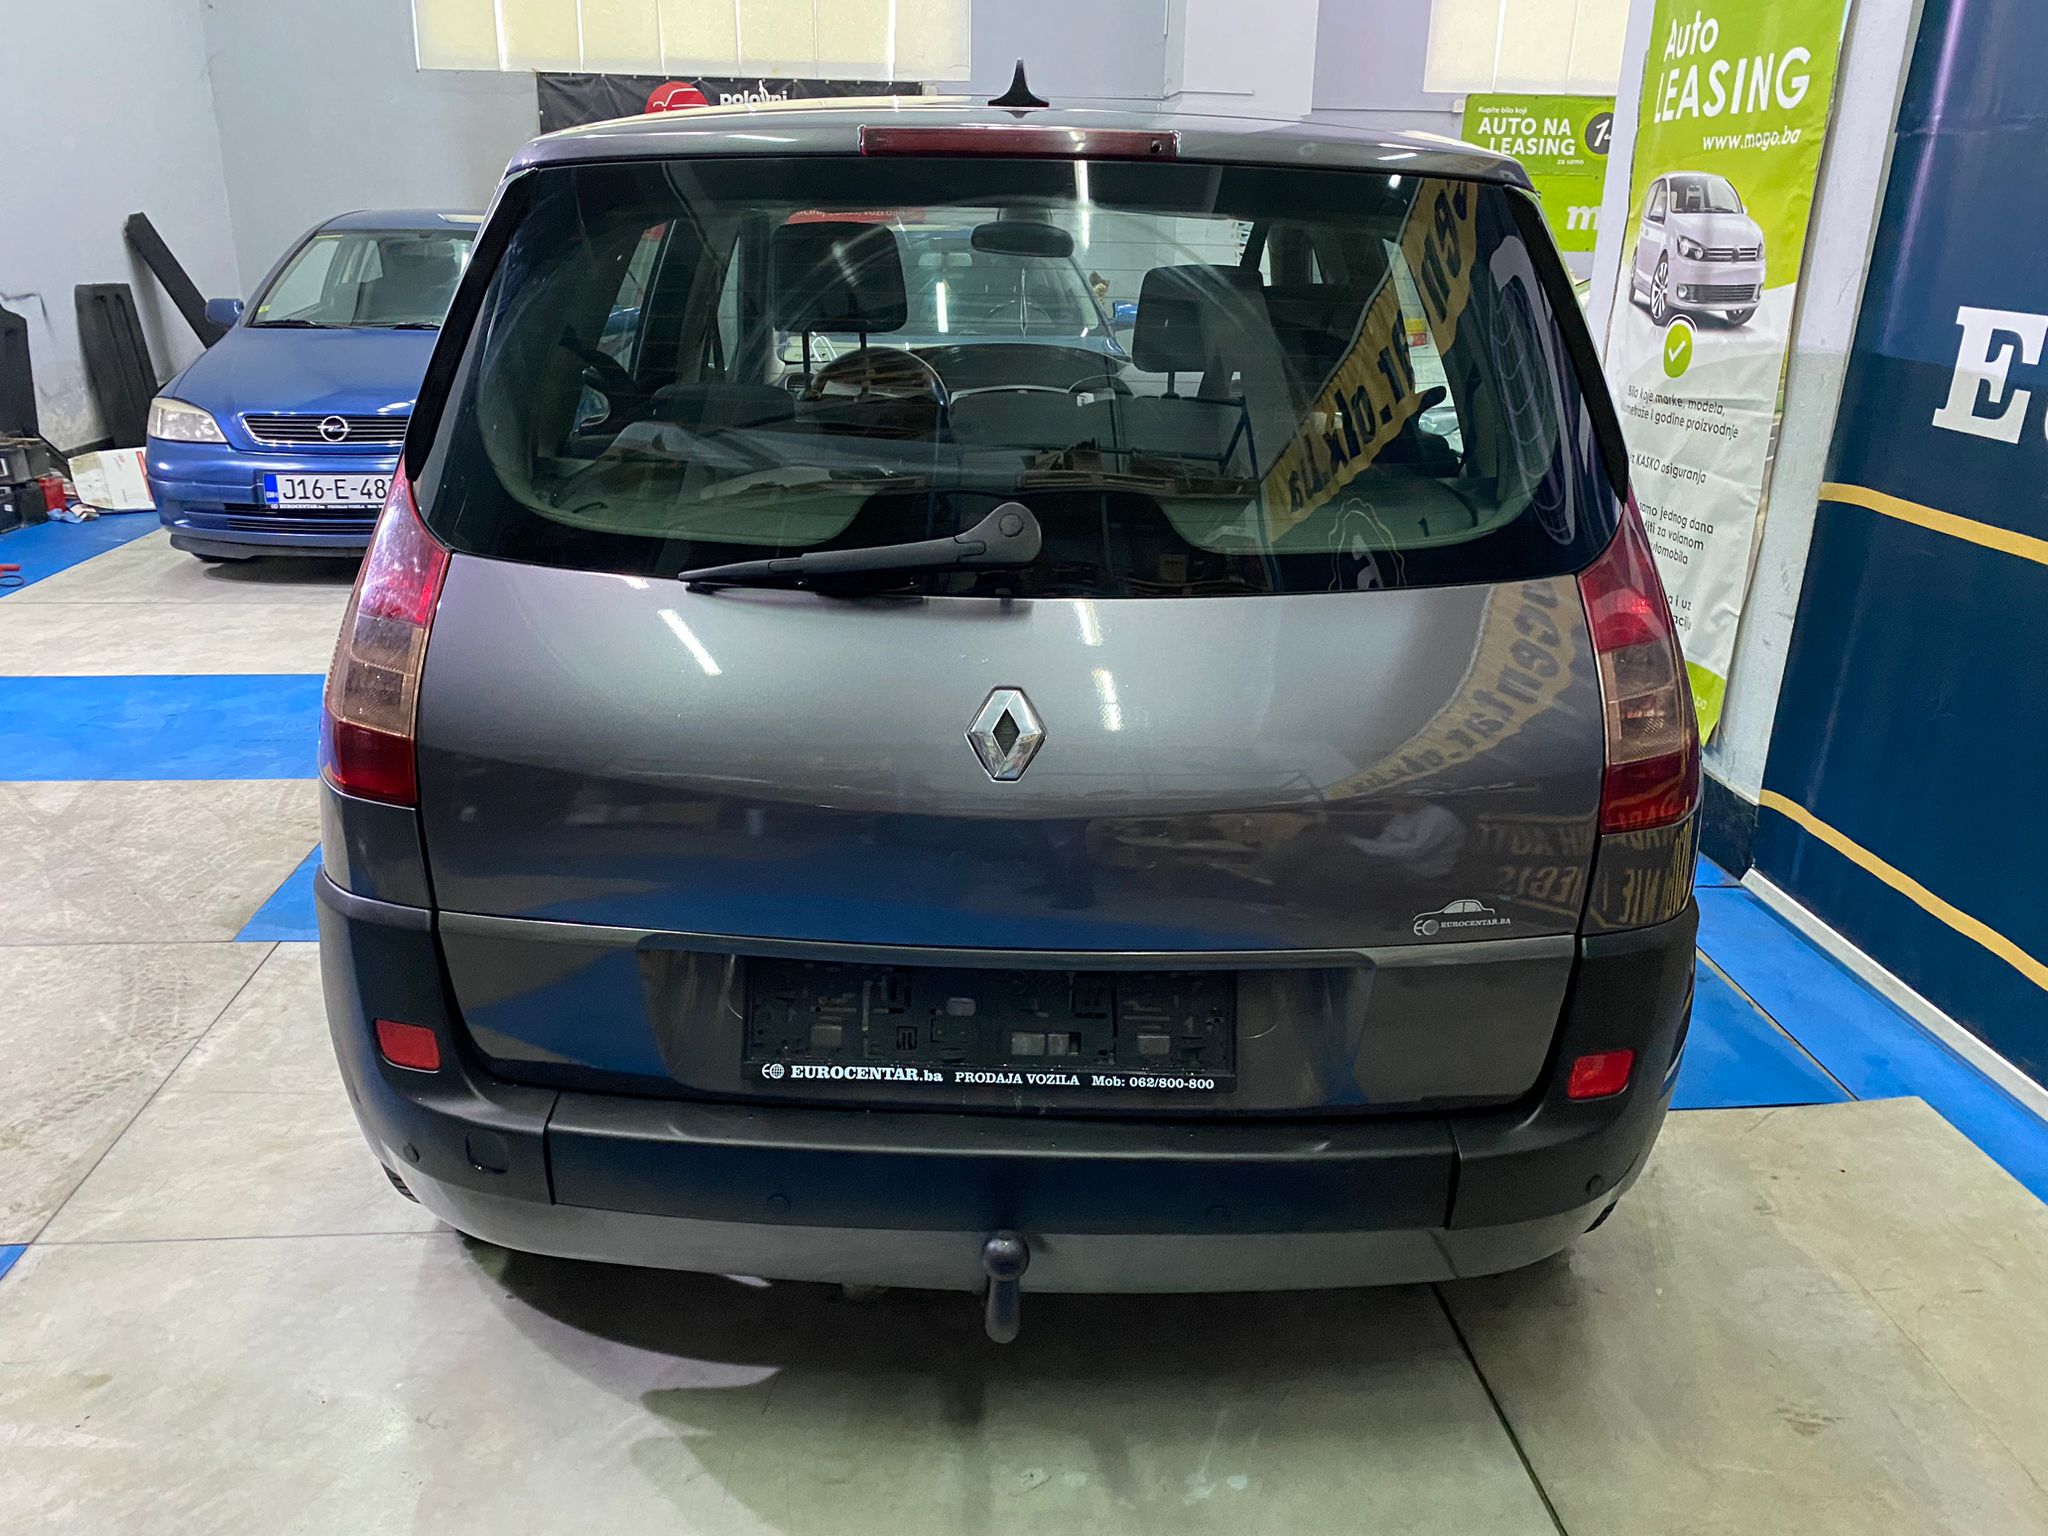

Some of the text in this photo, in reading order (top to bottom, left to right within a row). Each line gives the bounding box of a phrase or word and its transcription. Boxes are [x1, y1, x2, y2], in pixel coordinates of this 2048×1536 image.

[1663, 10, 1719, 62] Auto
[1654, 46, 1811, 123] LEASING
[1478, 117, 1571, 136] AUTO NA
[1702, 125, 1801, 151] www.mogo.ba
[1489, 137, 1576, 156] LEASING
[1640, 387, 1654, 404] koje
[1688, 400, 1725, 417] modela,
[1655, 412, 1685, 427] godine
[1685, 418, 1739, 440] proizvodnje
[1636, 453, 1660, 470] KASKO
[1661, 462, 1707, 485] osiguranja
[283, 478, 394, 500] J16-E-48
[1660, 506, 1688, 529] jednog
[1689, 517, 1714, 535] dana
[1657, 526, 1666, 538] za
[1668, 530, 1704, 551] volanom
[1681, 600, 1692, 611] uz
[791, 1065, 1215, 1090] EUROCENTAR.ba PRODAJA VOZILA Mob: 062/800-800
